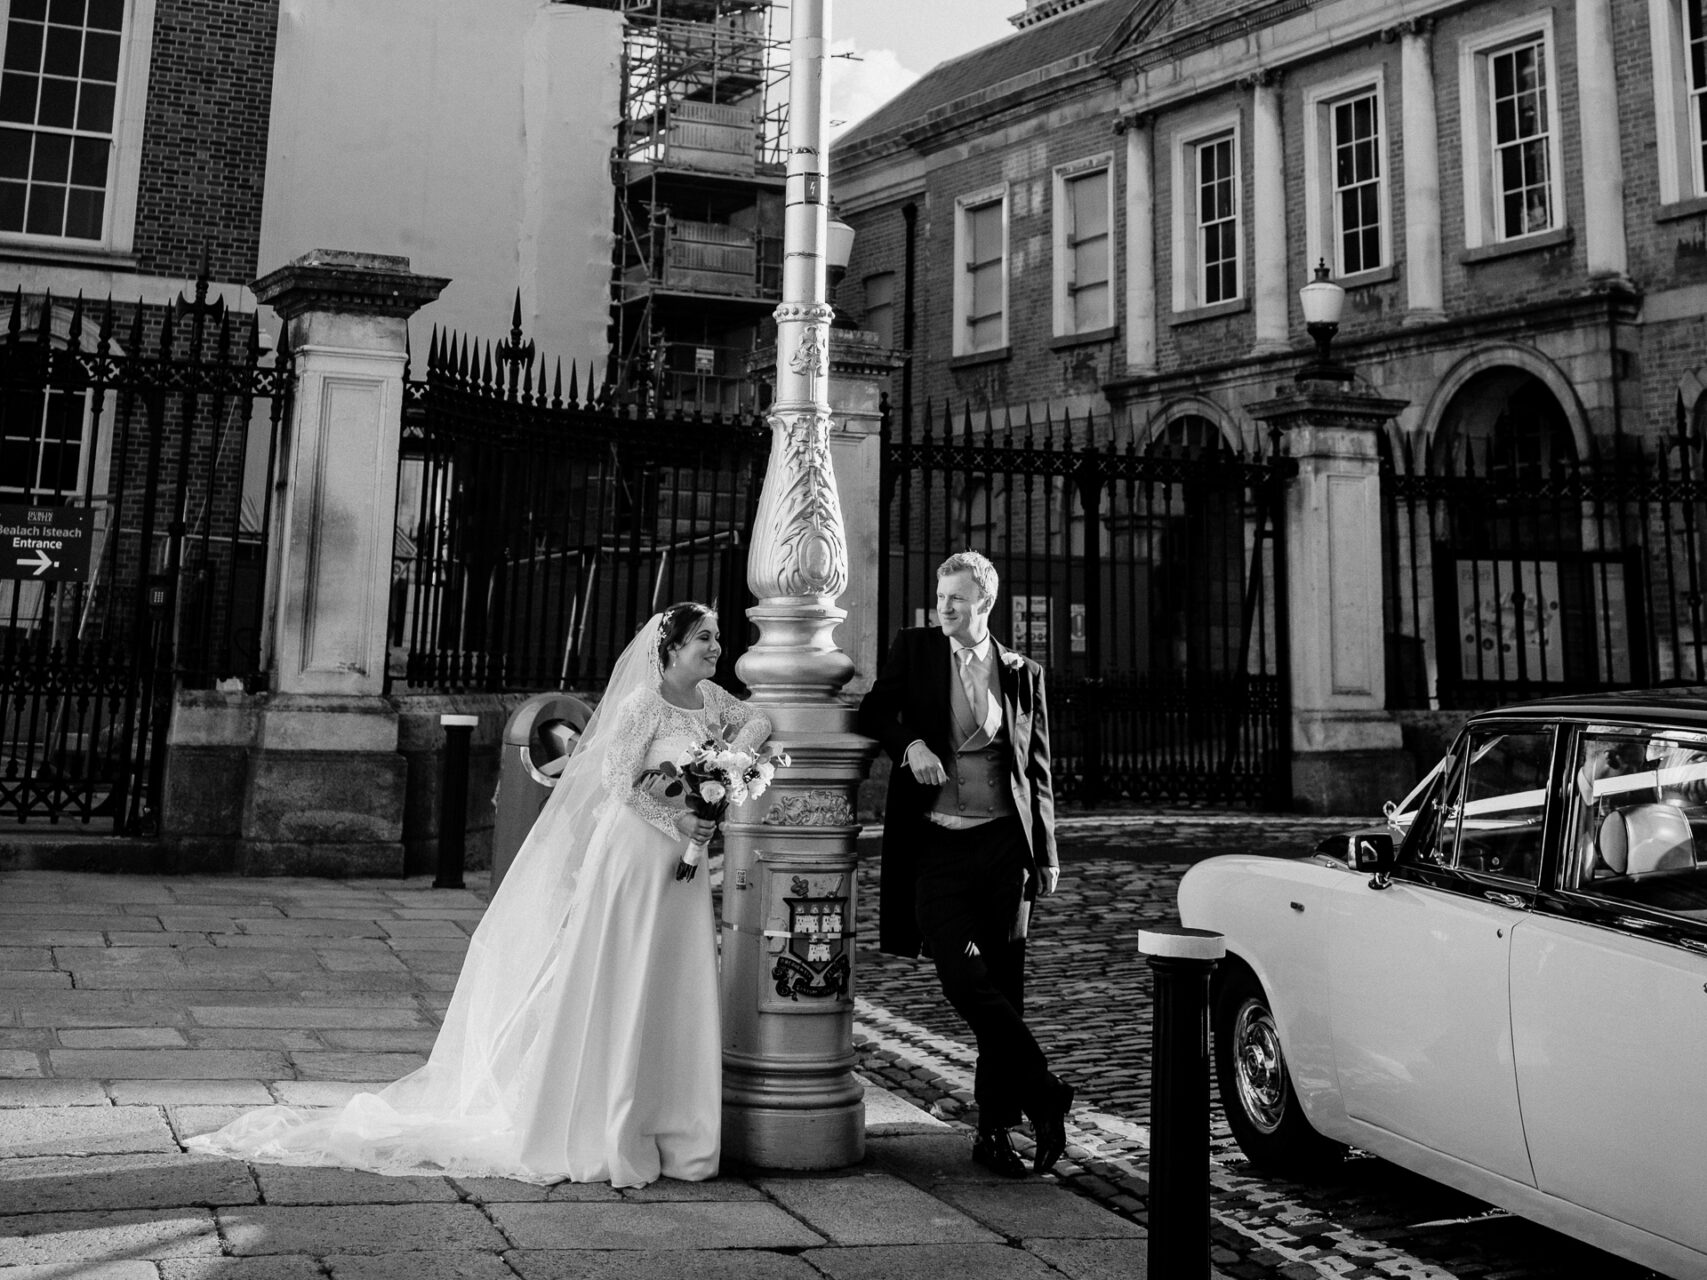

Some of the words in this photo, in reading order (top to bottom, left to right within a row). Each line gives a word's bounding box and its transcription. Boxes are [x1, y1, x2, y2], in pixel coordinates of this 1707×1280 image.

[0, 524, 39, 536] Bealach
[43, 526, 82, 538] Isteach
[13, 537, 62, 549] Entrance
